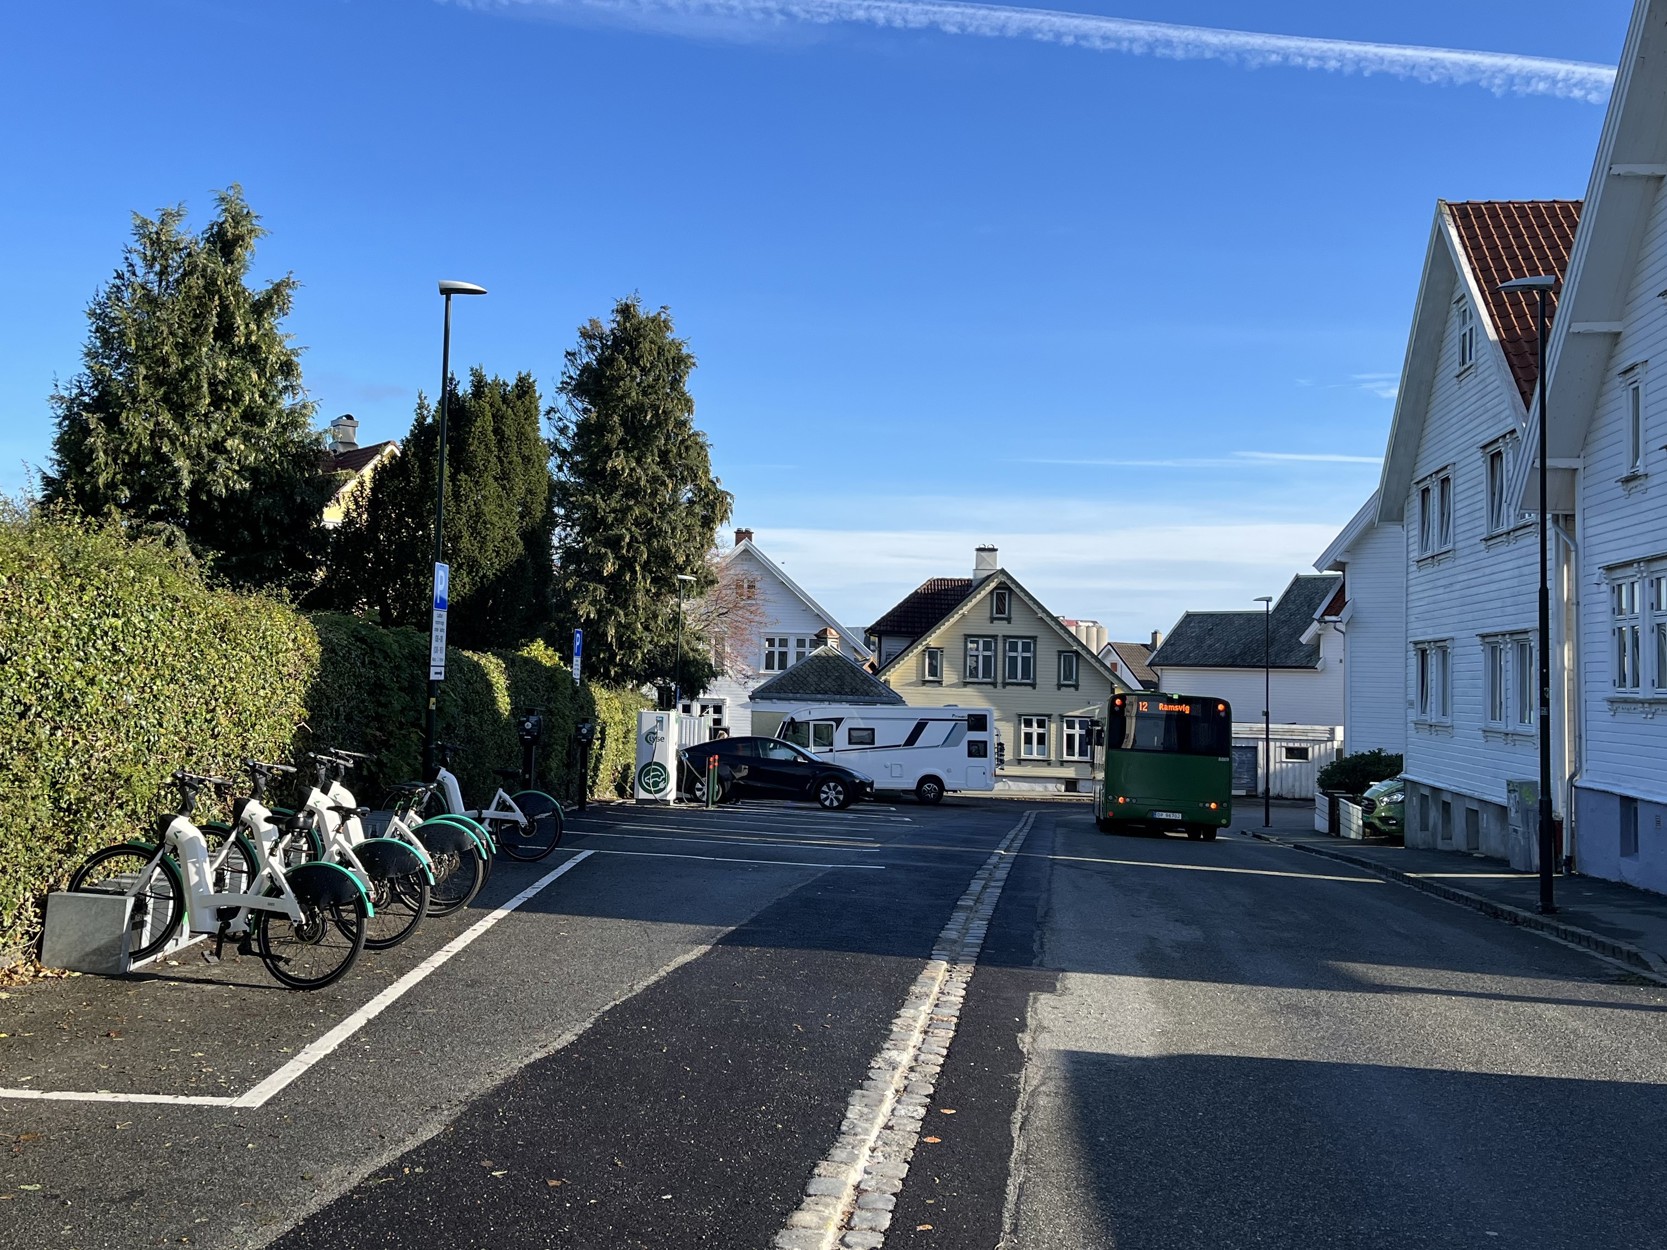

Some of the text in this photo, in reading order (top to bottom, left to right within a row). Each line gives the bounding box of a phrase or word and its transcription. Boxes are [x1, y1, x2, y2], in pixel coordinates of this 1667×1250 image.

[437, 570, 445, 603] P
[575, 633, 580, 653] P
[1139, 702, 1190, 714] 12 Ramsvig
